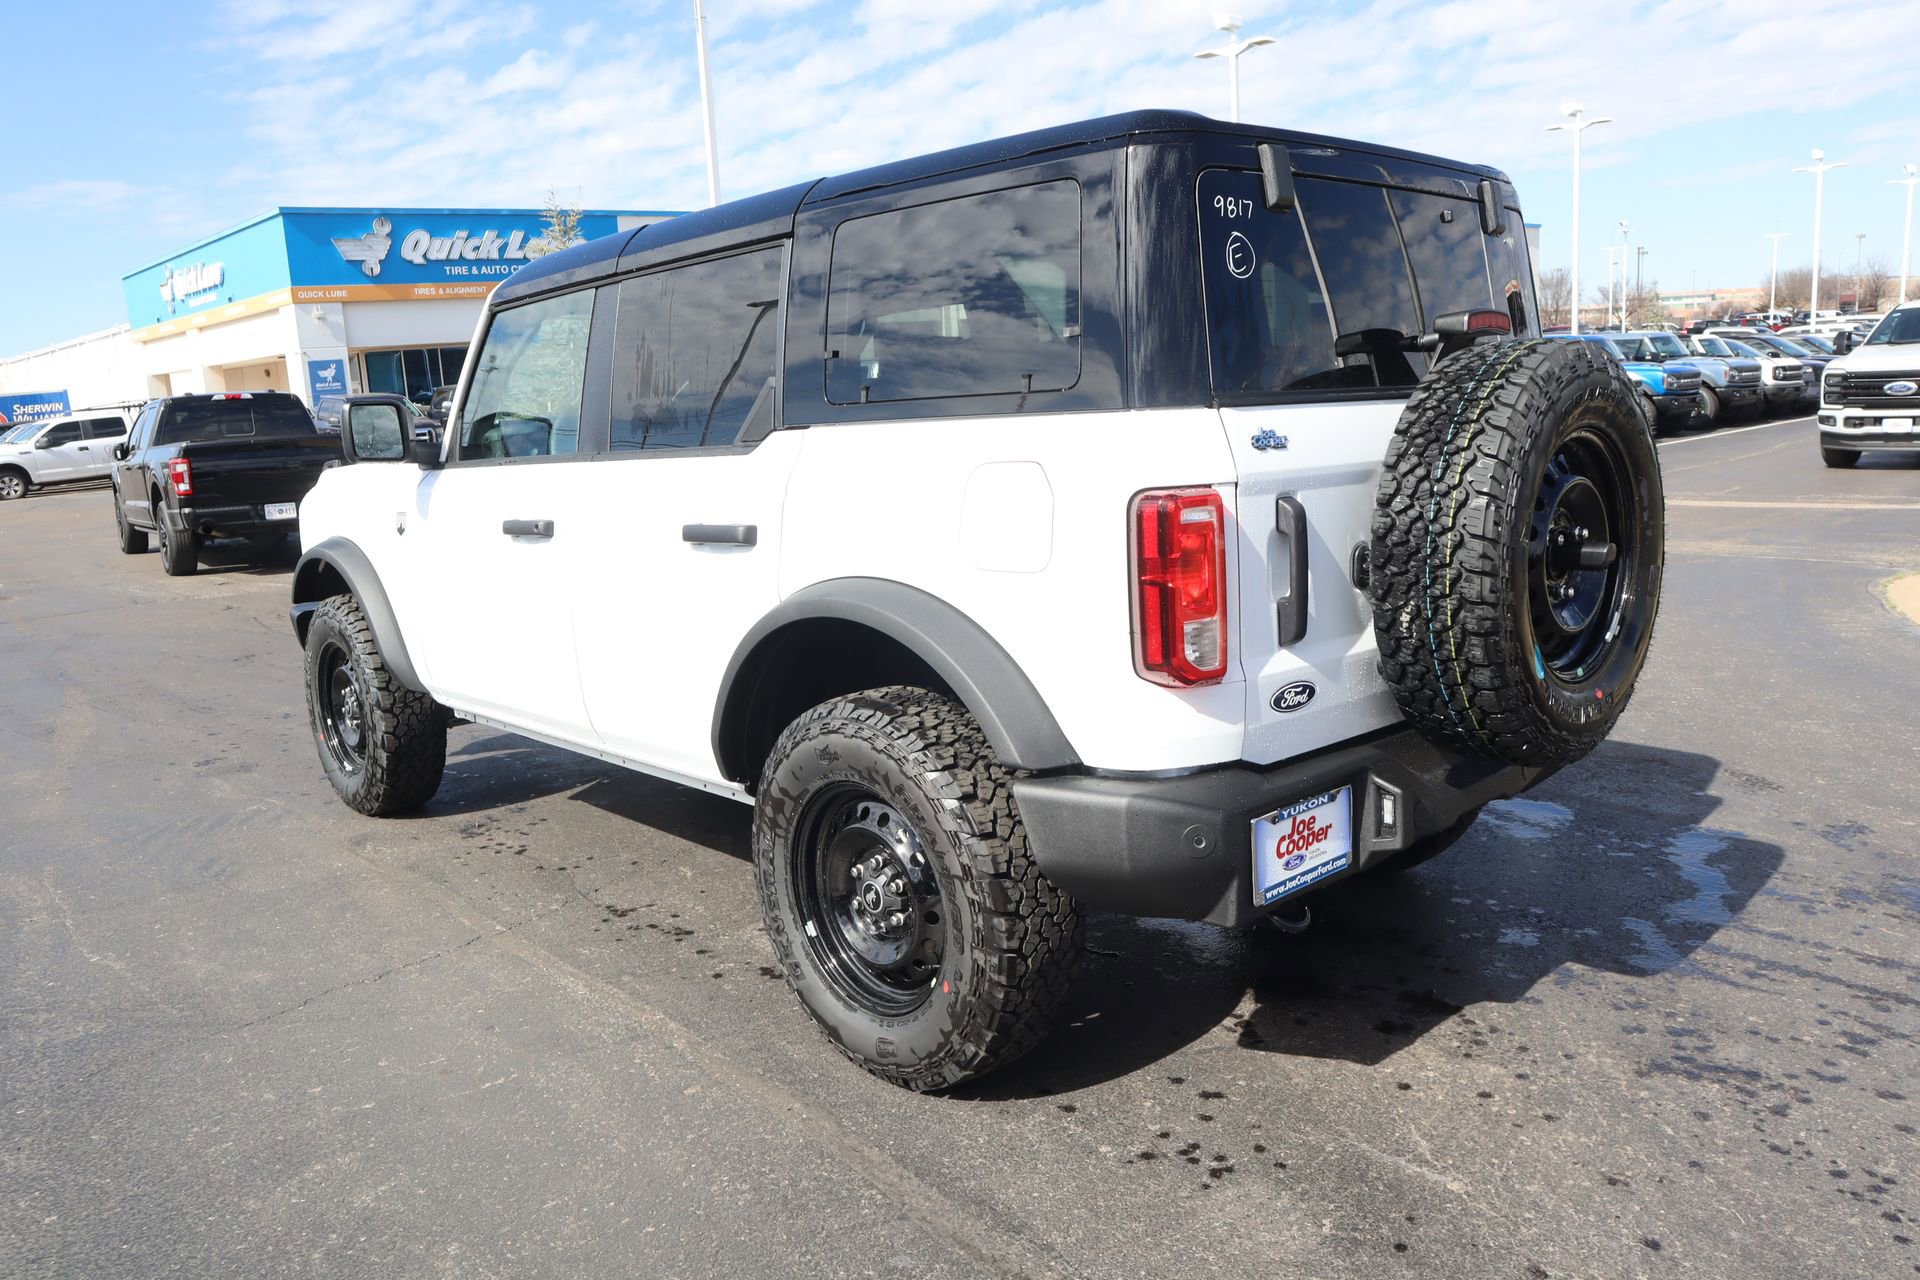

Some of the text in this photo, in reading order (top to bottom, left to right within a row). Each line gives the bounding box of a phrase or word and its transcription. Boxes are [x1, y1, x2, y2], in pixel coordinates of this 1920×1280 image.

[1214, 195, 1253, 219] 9817
[401, 229, 588, 265] Quick La
[1229, 242, 1247, 273] E
[444, 266, 469, 276] TIRE
[471, 266, 479, 275] &
[480, 265, 509, 275] AUTO
[298, 290, 324, 299] QUICK
[326, 289, 347, 298] LUBE
[414, 286, 487, 295] TIRES & ALIGNMENT
[13, 402, 63, 415] SHERWIN
[1252, 435, 1288, 449] Cooper
[1258, 426, 1276, 438] Joe
[1281, 686, 1309, 708] Ford
[1281, 794, 1329, 819] YUKON
[1287, 815, 1316, 840] Joe
[1276, 823, 1333, 859] Cooper
[1265, 857, 1347, 900] www.JoeCooperFord.com
